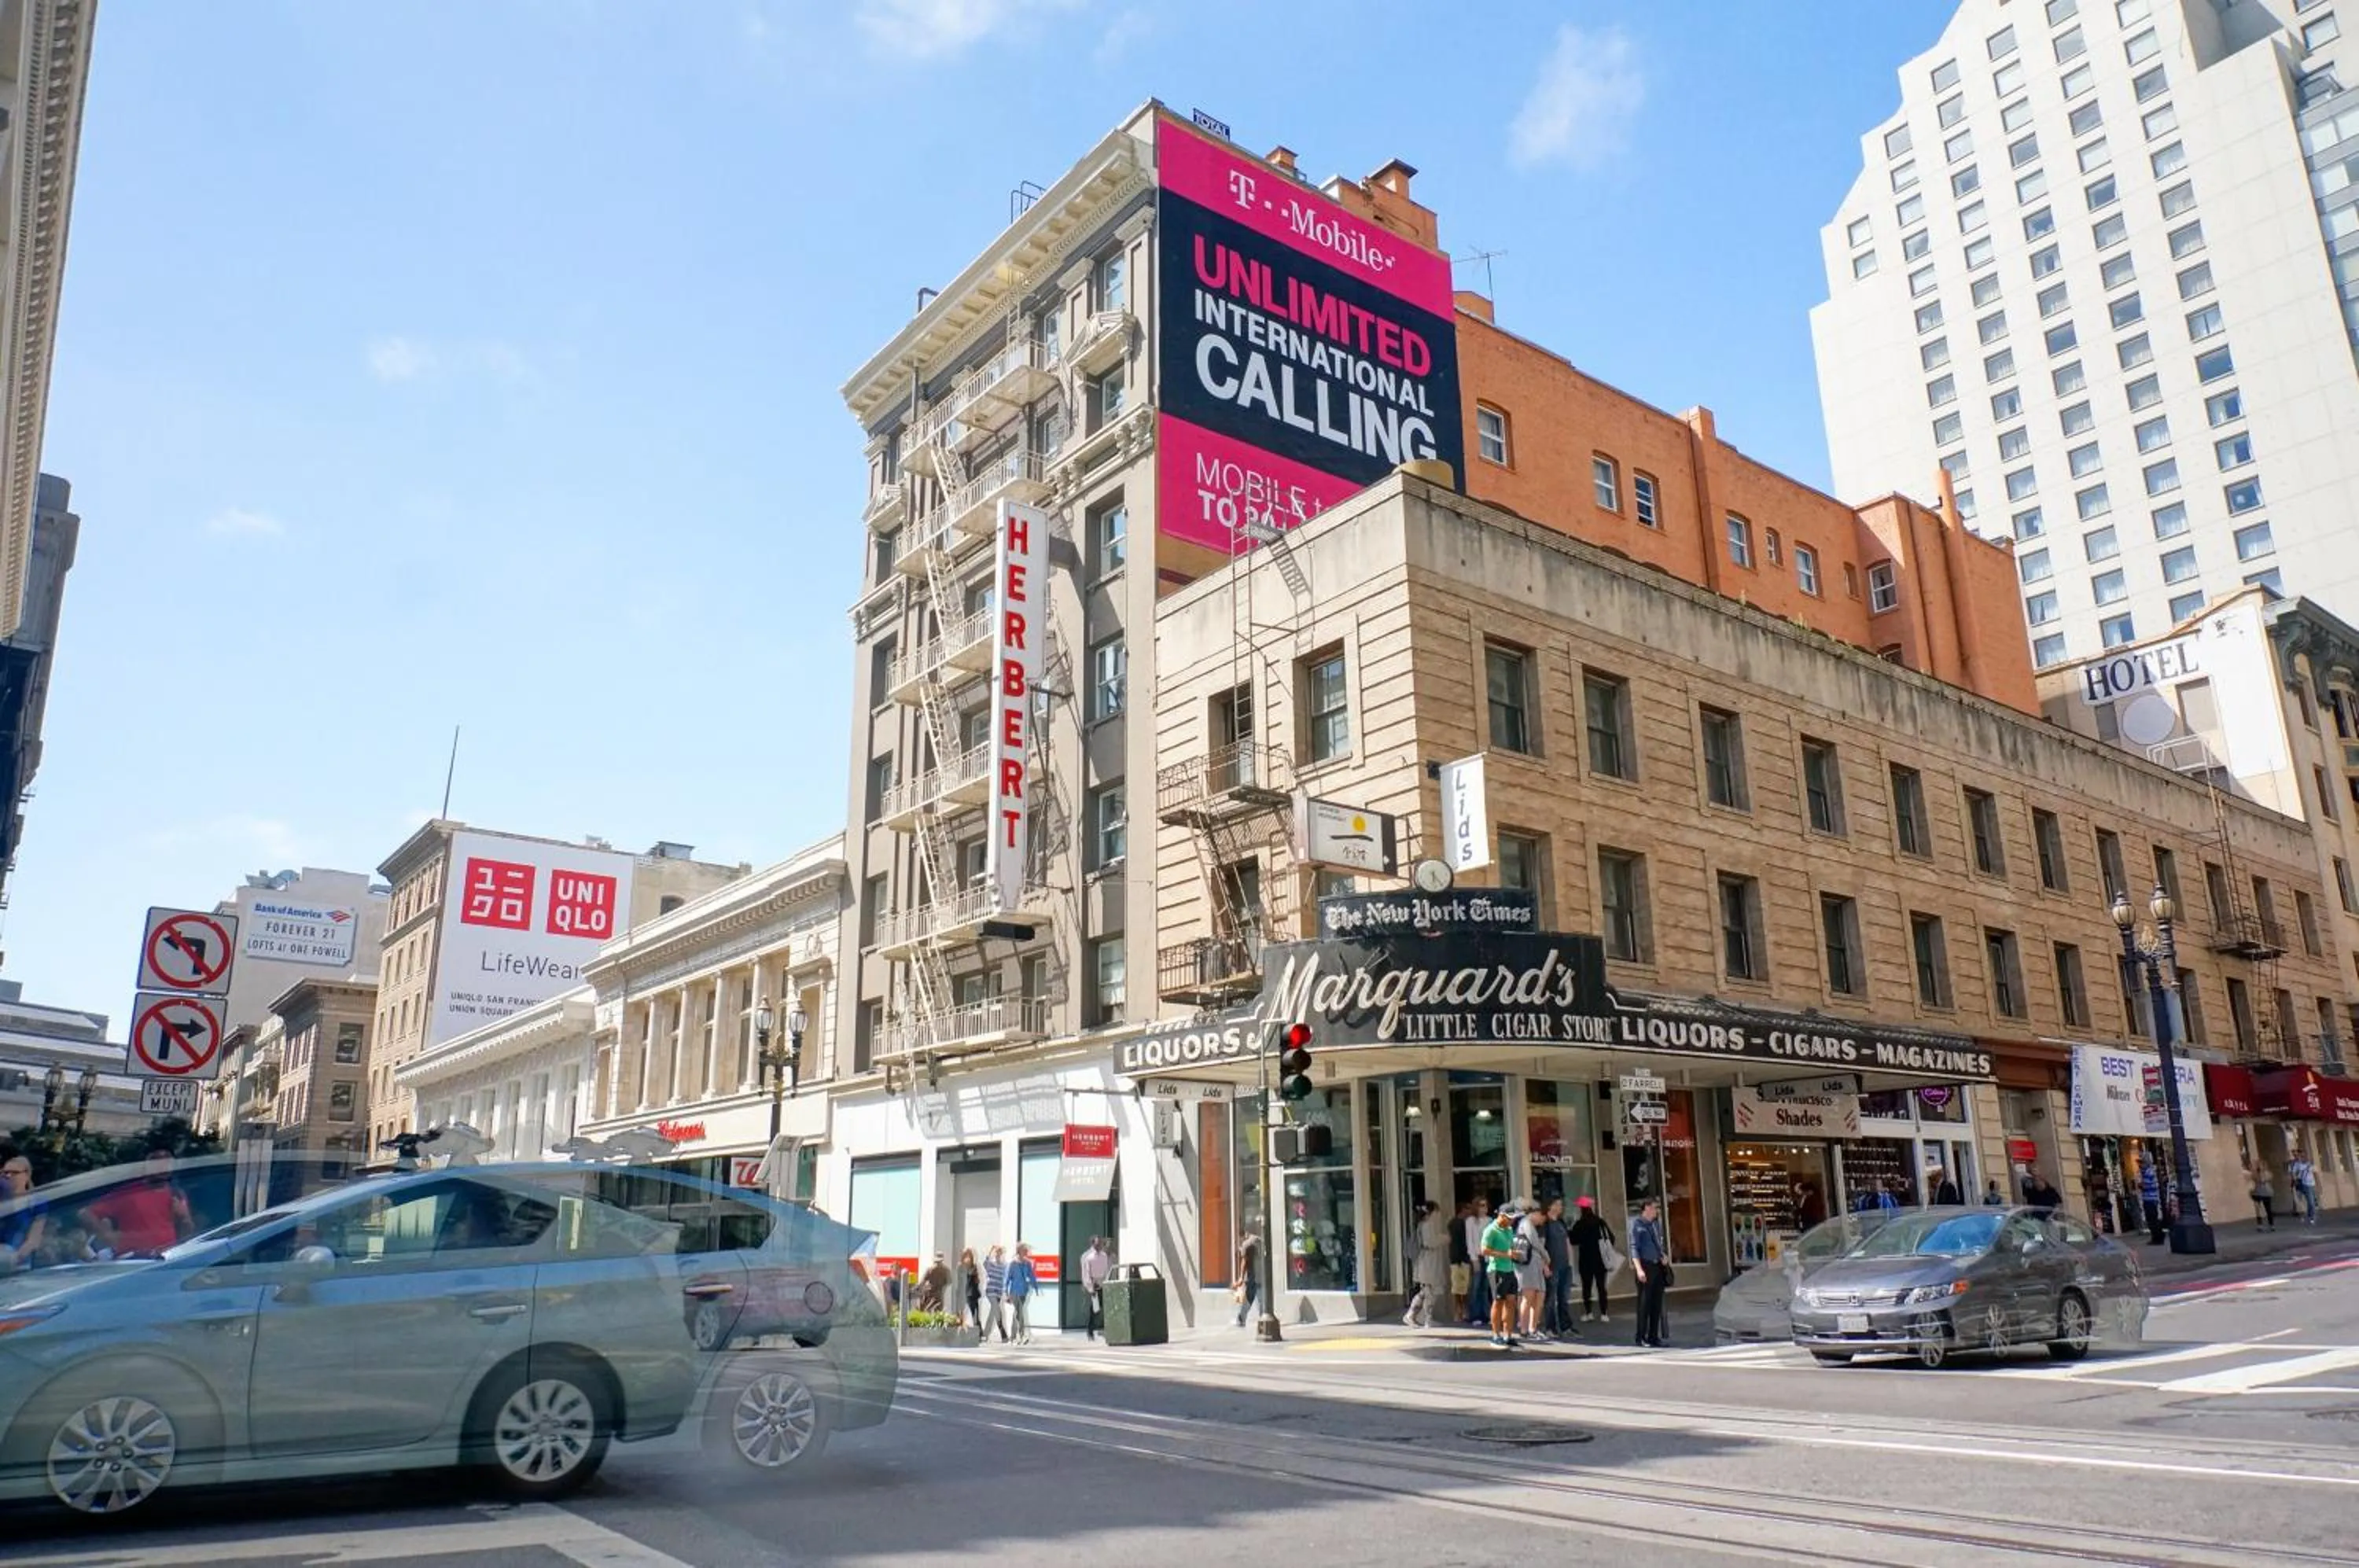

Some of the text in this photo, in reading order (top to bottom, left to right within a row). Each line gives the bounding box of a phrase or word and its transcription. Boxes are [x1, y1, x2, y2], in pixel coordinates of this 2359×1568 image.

[1194, 234, 1433, 377] UNLIMITED
[1194, 289, 1435, 417] INTERNATIONAL
[1195, 333, 1437, 465] CALLING
[1196, 452, 1307, 517] MOBILE
[1198, 488, 1238, 528] TO
[1001, 516, 1029, 848] HERBERT
[2085, 641, 2199, 701] HOTEL
[1456, 769, 1473, 862] Lids
[557, 877, 605, 905] UNI
[255, 903, 322, 918] Bank of America
[554, 905, 607, 932] QLO
[1325, 896, 1532, 929] The New York Times
[266, 920, 336, 939] FOREVER 21
[247, 938, 274, 951] LOFTS
[290, 943, 308, 954] ONE
[311, 946, 347, 959] POWELL
[451, 992, 483, 1002] UNIQLO
[487, 995, 504, 1004] SAN
[1263, 948, 1576, 1040] Marquard's
[449, 1003, 476, 1014] UNION
[1491, 1012, 1552, 1039] CIGAR
[1123, 1027, 1240, 1068] LIQUORS
[1621, 1015, 1746, 1051] LIQUORS
[1768, 1031, 1857, 1061] CIGARS
[1875, 1041, 1991, 1074] MAGAZINES
[2100, 1056, 2134, 1080] BEST
[147, 1083, 192, 1095] EXCEPT
[1157, 1084, 1178, 1095] Lids
[1822, 1080, 1843, 1091] Lids
[150, 1097, 188, 1111] MUNI
[1776, 1107, 1824, 1127] Shades
